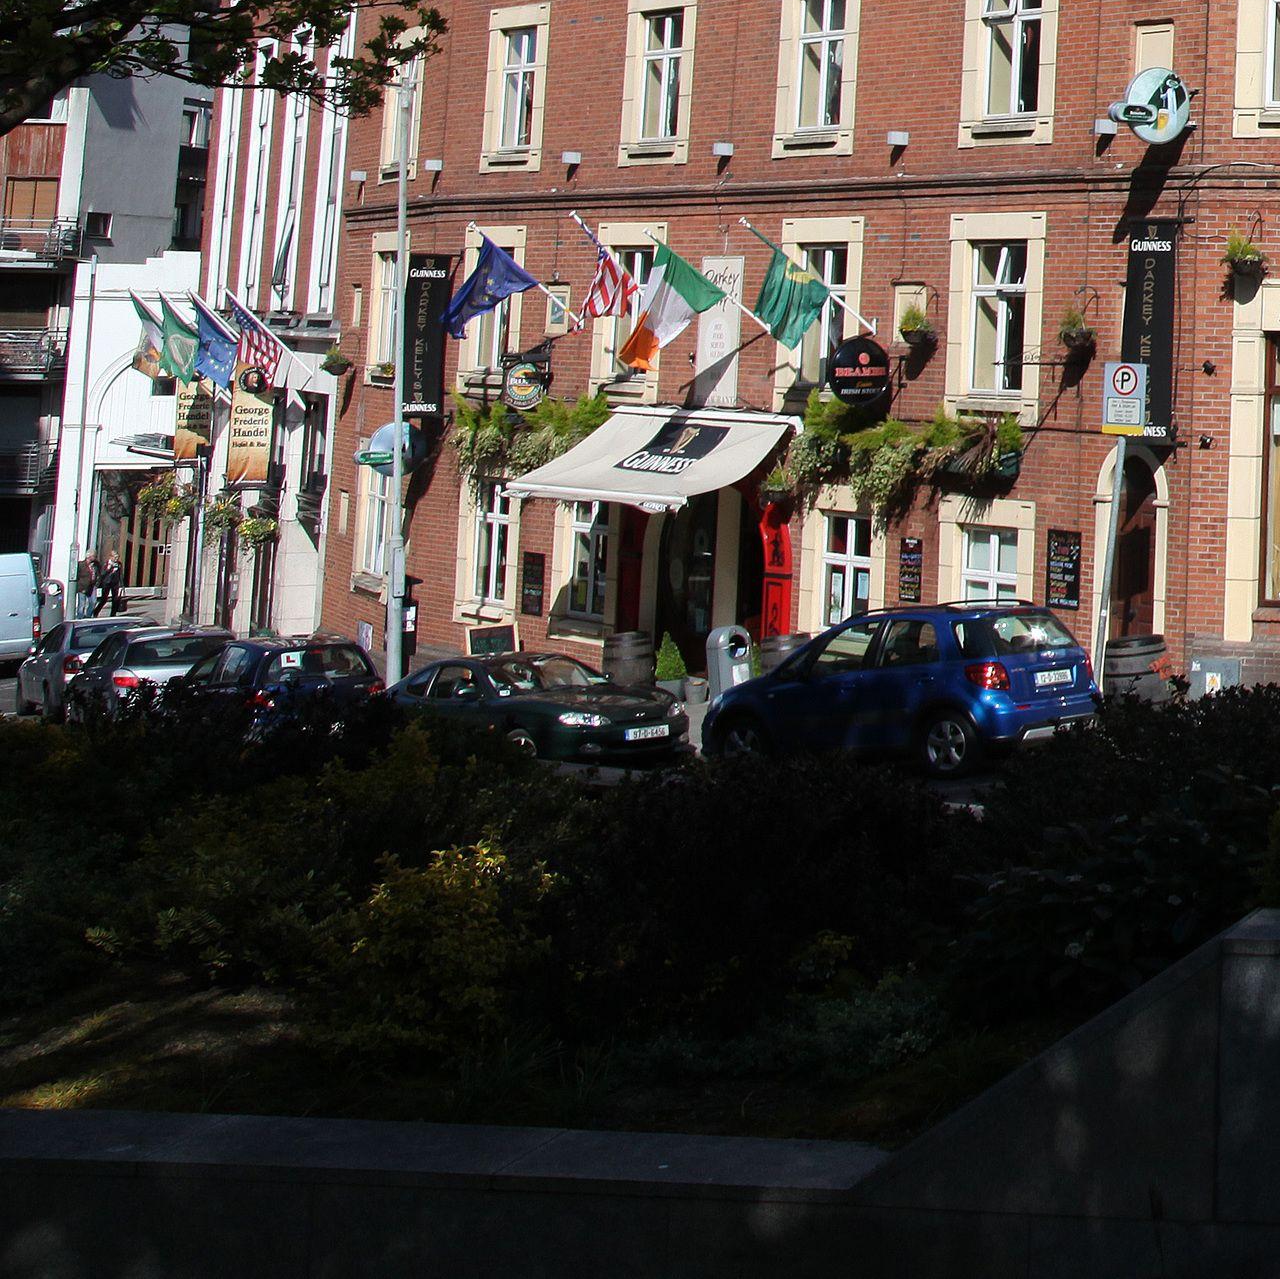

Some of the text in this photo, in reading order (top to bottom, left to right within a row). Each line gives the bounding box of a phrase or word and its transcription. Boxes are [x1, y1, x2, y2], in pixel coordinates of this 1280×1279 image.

[1131, 239, 1173, 252] GUINNESS
[410, 268, 447, 279] GUINNESS
[1143, 258, 1156, 326] DARKEY
[1120, 371, 1131, 389] P
[179, 392, 210, 402] George
[178, 402, 210, 411] Frederic
[235, 405, 270, 417] George
[401, 402, 437, 413] GUINNESS
[233, 417, 269, 426] Frederic
[232, 428, 268, 437] Handel
[622, 450, 698, 473] GUINNESS
[286, 655, 296, 663] L
